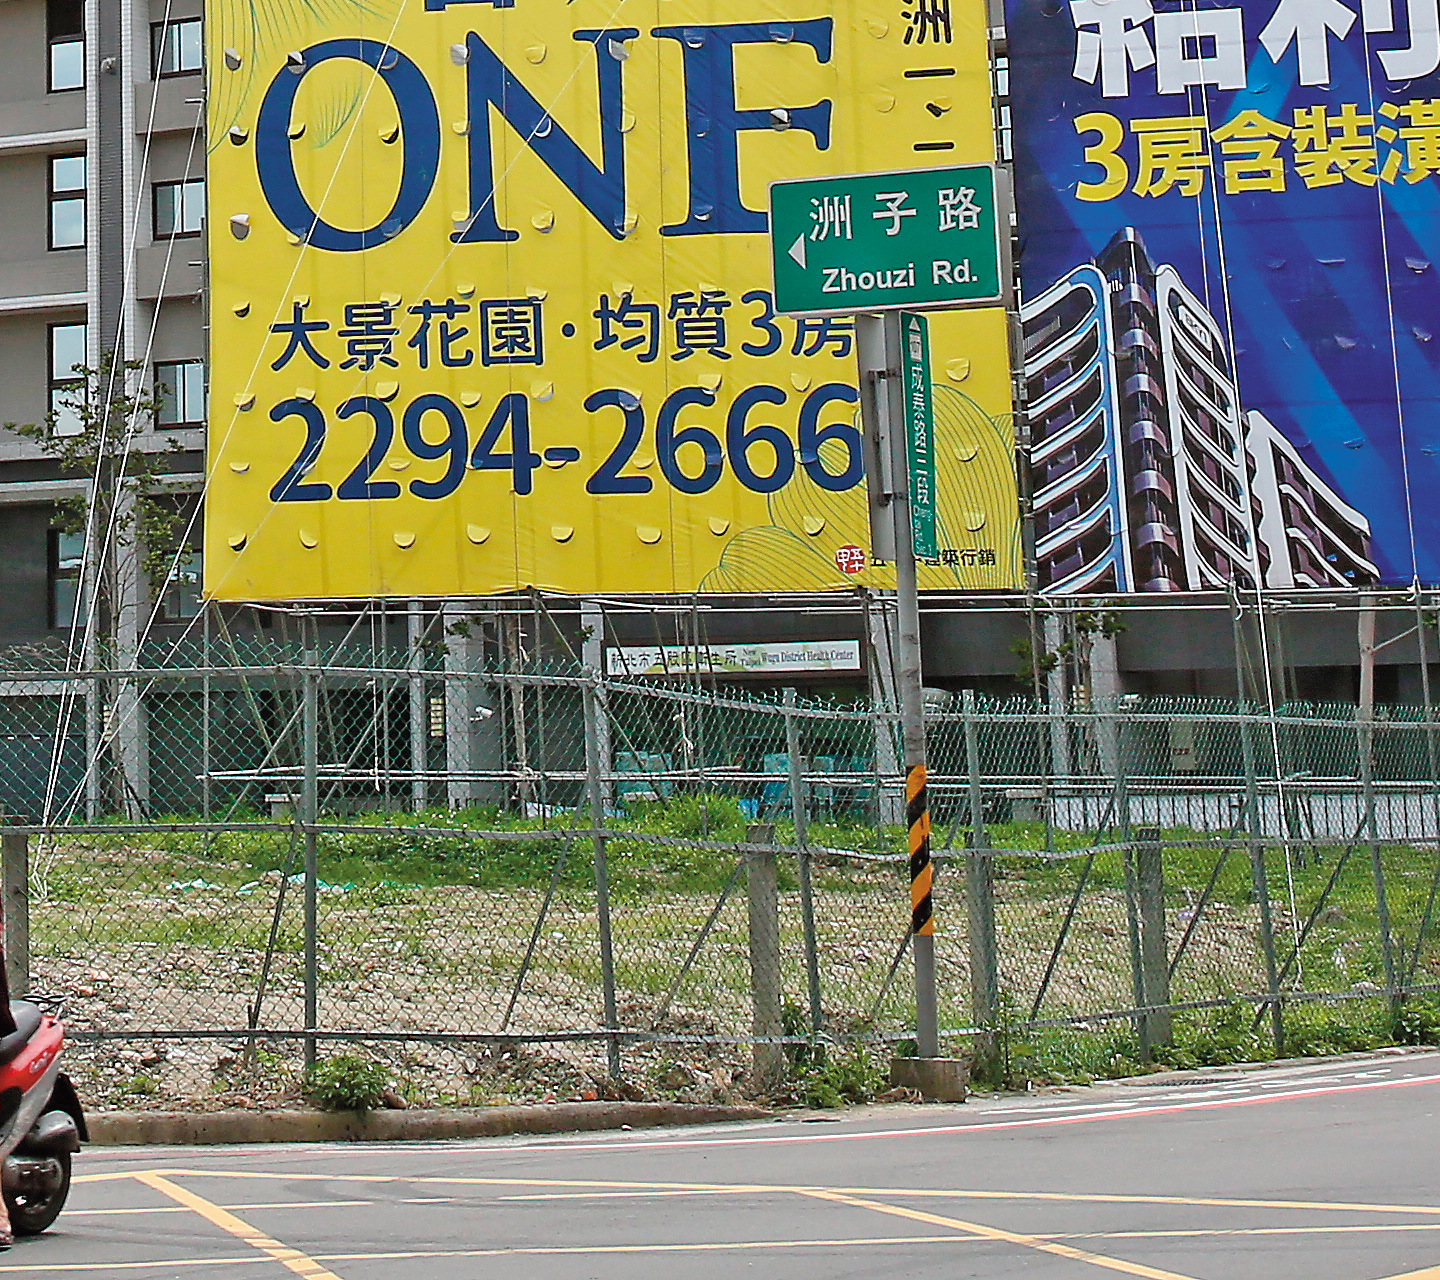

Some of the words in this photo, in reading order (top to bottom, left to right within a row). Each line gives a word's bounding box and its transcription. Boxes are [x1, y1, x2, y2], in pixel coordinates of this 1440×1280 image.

[254, 18, 833, 252] ONE
[809, 185, 982, 242] 洲子路
[821, 262, 916, 293] Zhouzi
[932, 259, 979, 285] Rd.
[267, 382, 866, 502] 2294-2666
